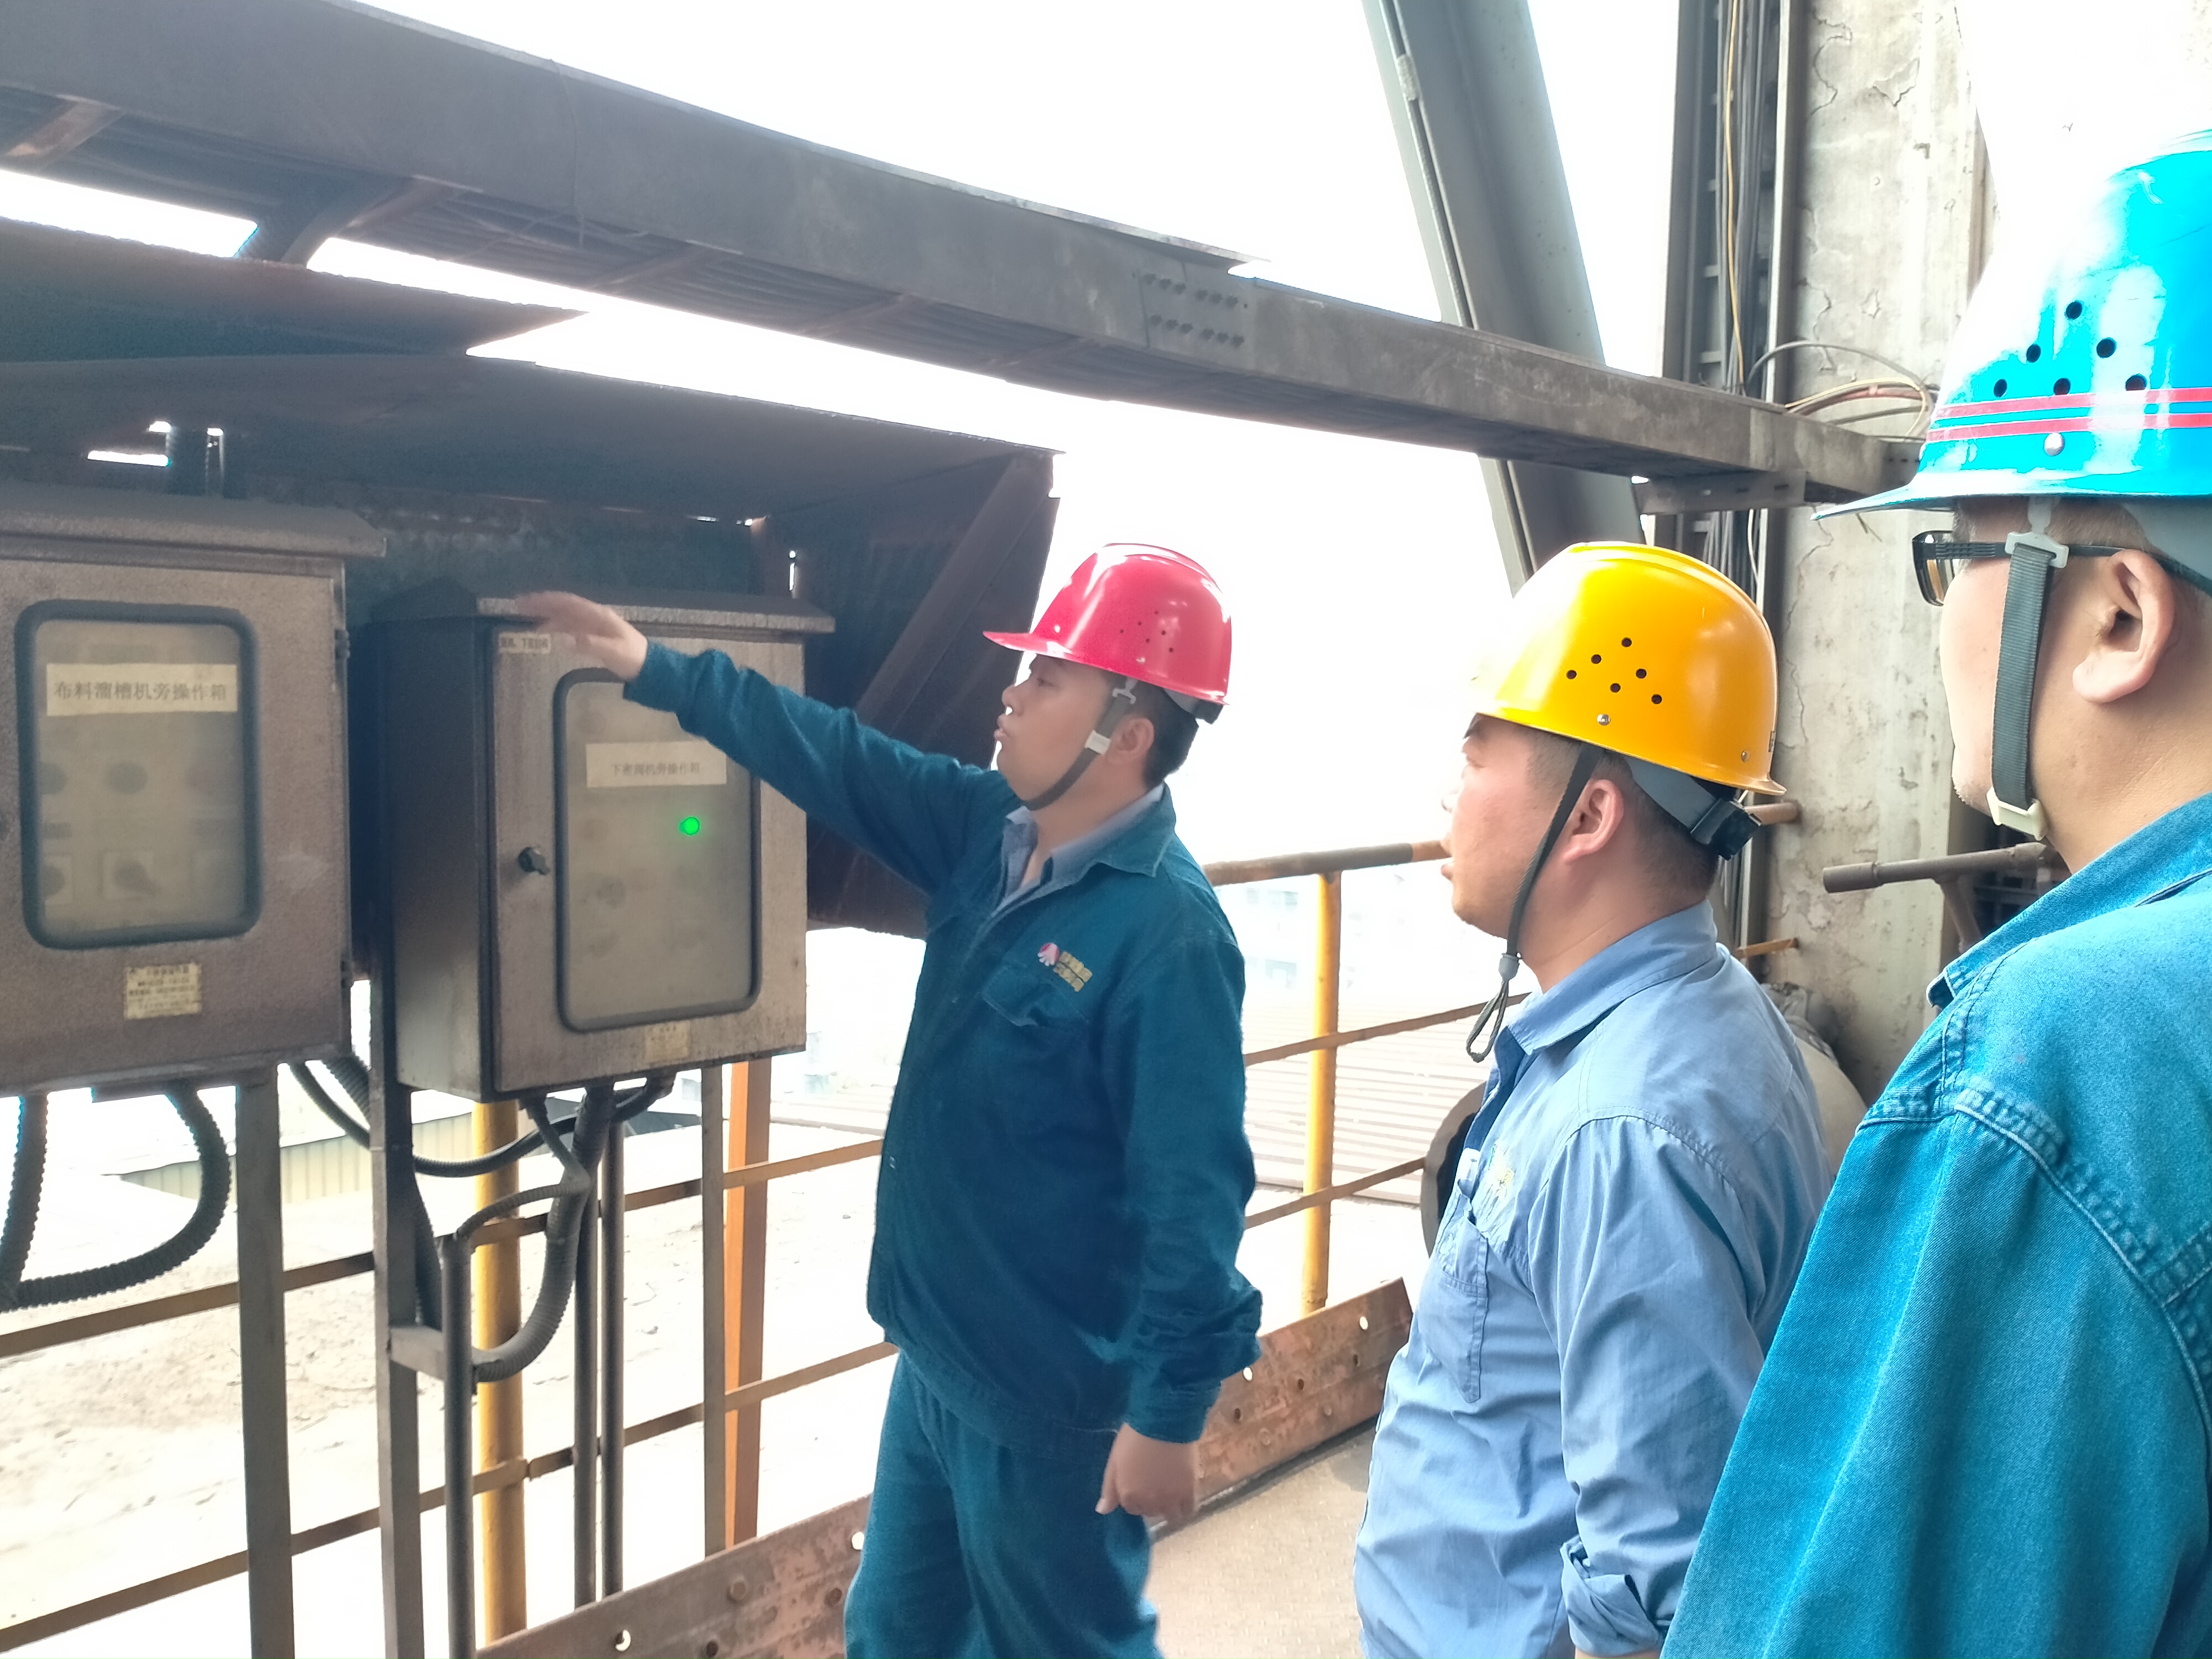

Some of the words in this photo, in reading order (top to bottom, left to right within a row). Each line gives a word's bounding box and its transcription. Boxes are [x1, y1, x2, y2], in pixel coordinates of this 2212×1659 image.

[54, 681, 227, 701] 布料溜槽机旁操作箱
